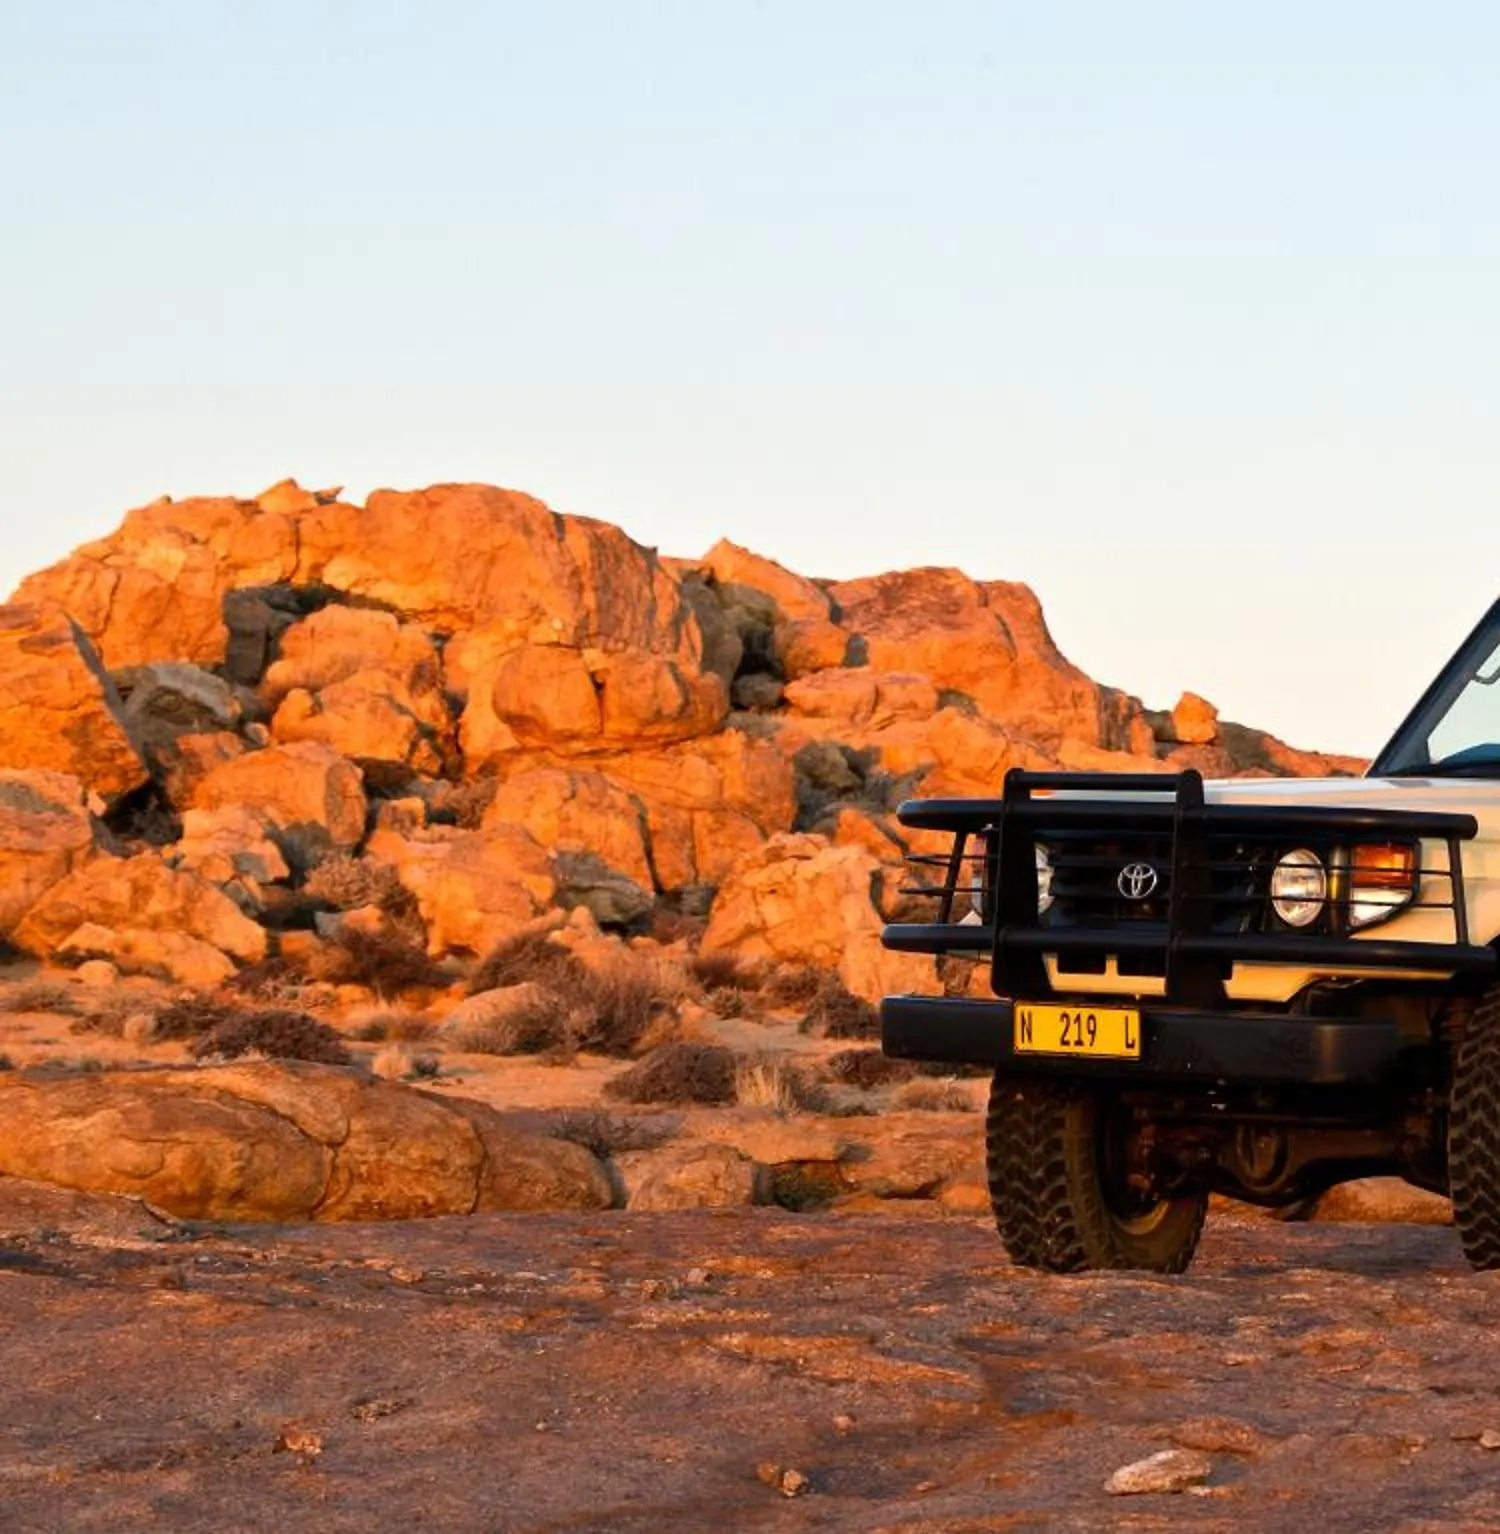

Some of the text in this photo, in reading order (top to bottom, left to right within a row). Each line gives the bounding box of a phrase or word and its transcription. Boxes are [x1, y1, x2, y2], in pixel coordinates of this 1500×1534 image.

[1021, 1011, 1135, 1049] N 219 L
